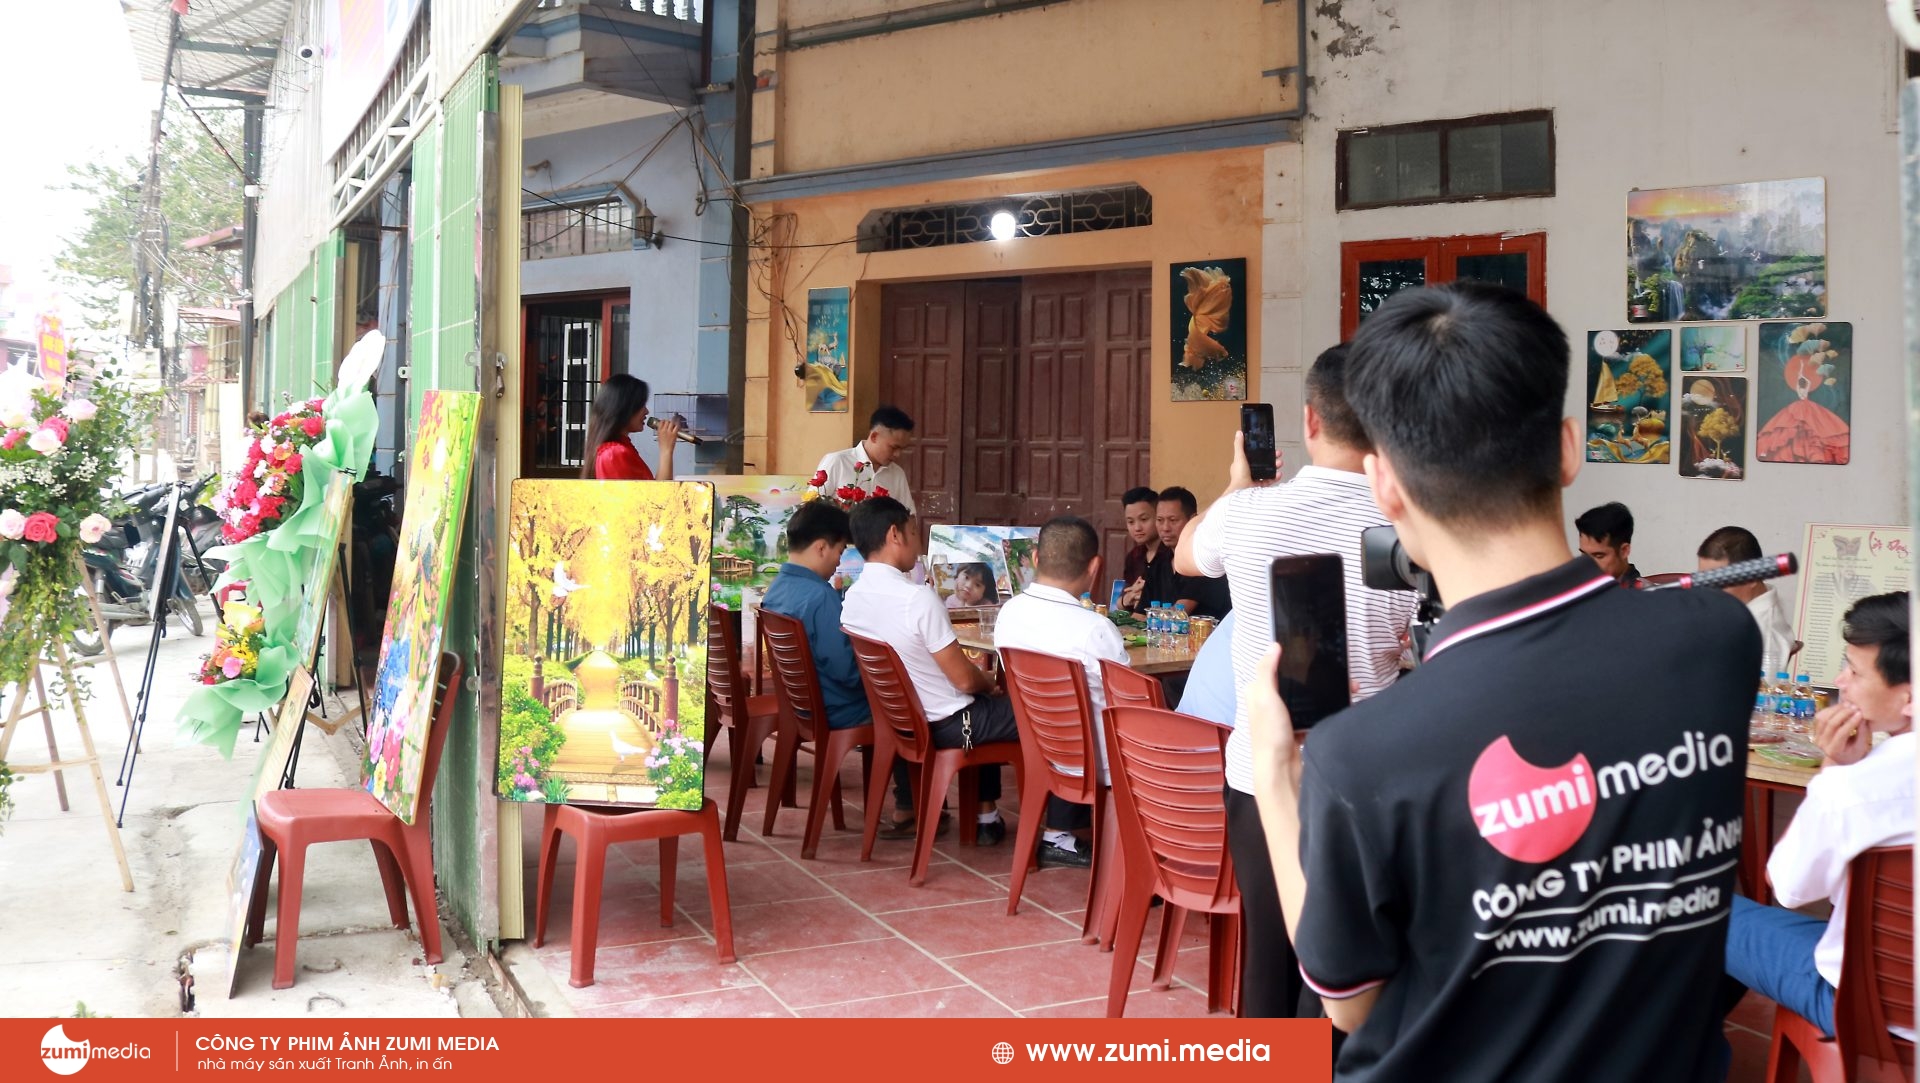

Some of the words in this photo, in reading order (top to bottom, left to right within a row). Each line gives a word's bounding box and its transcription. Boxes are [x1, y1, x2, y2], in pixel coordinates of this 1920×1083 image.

[1475, 763, 1591, 838] zumi
[1597, 731, 1734, 799] media
[1472, 868, 1567, 922] CÔNG
[1570, 856, 1609, 893] TY
[1612, 835, 1693, 874] PHIM
[1495, 886, 1721, 951] www.zumi.media
